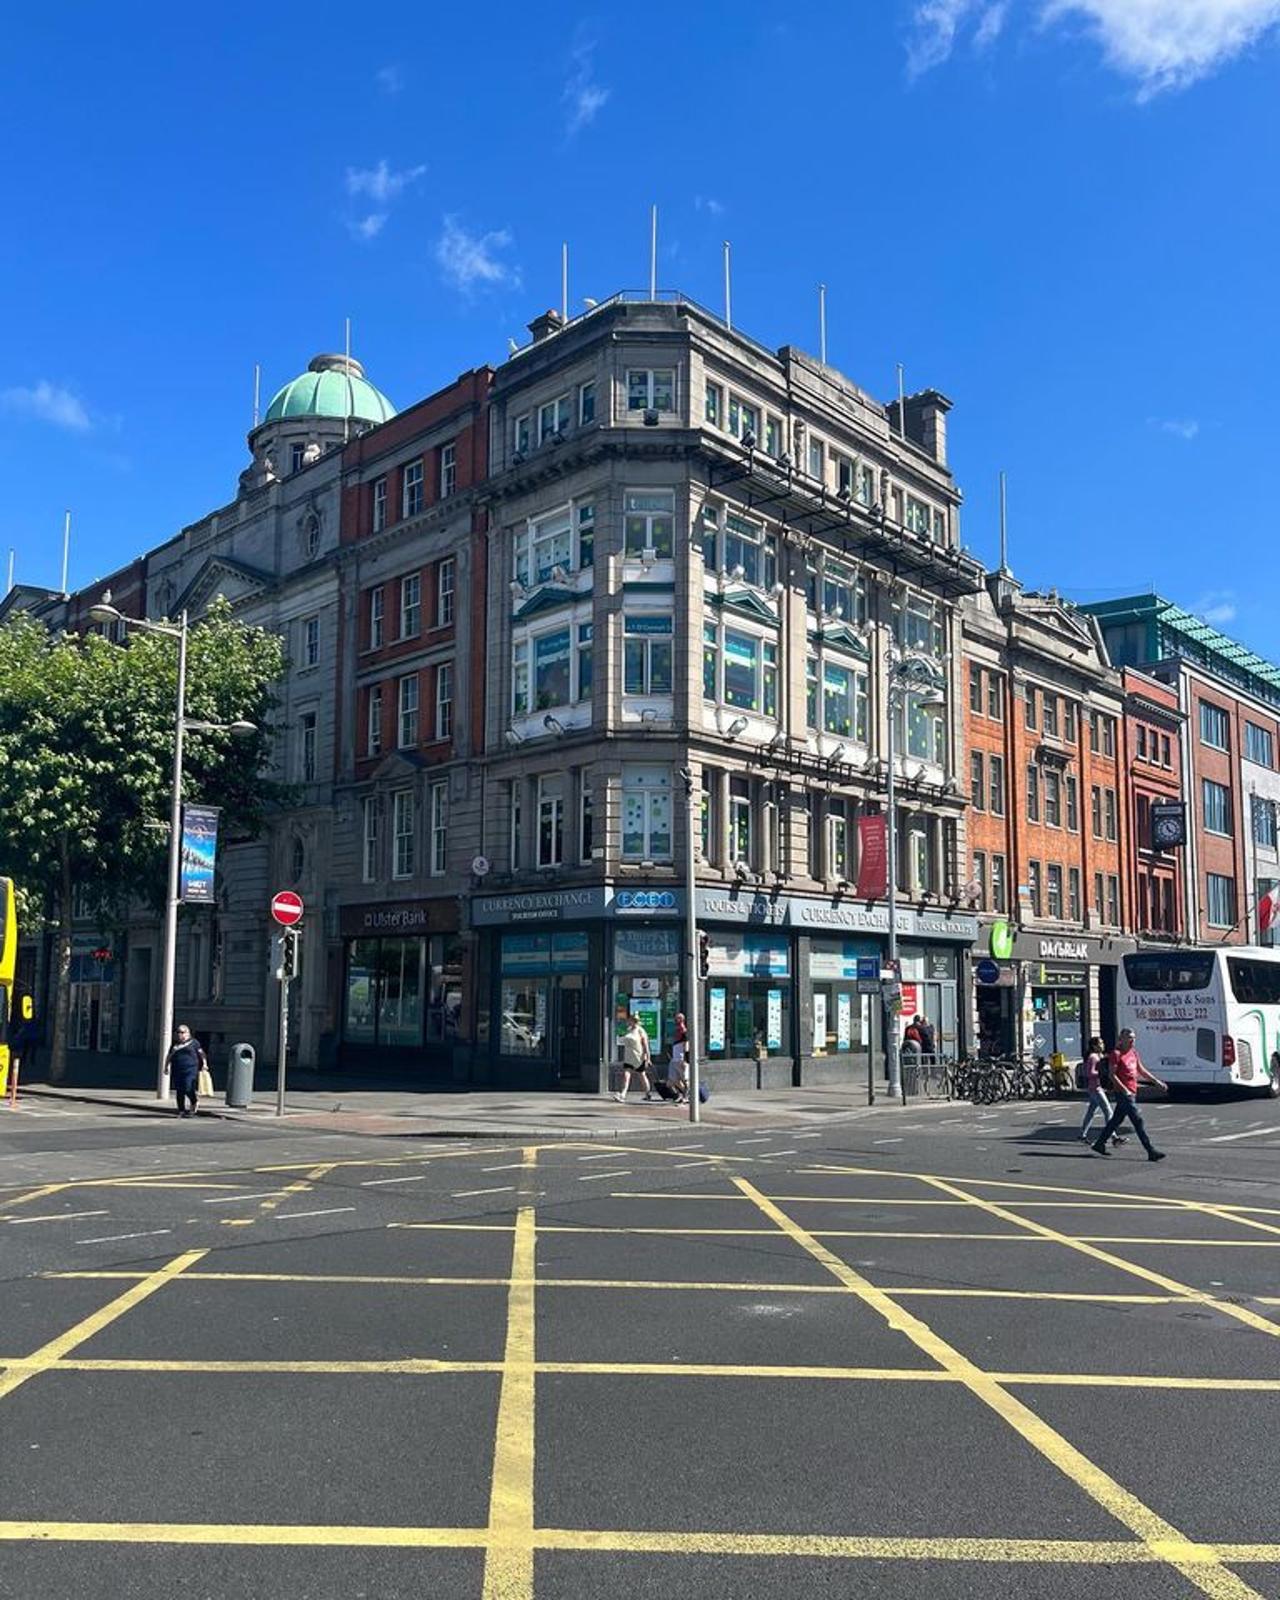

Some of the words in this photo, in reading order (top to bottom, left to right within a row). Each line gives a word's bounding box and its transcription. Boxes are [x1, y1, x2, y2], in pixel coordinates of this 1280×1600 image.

[482, 895, 533, 913] CURRENCY
[536, 891, 592, 908] EXCHANGE
[704, 898, 737, 914] TOURS
[372, 911, 400, 927] Ulster
[402, 909, 427, 926] Bank
[801, 906, 855, 926] CURRENCY
[857, 912, 909, 931] EXCHAGE
[1039, 940, 1089, 958] DAYBREAK
[1141, 995, 1182, 1007] Kavanagh
[1185, 995, 1193, 1005] &
[1195, 995, 1216, 1005] Sons
